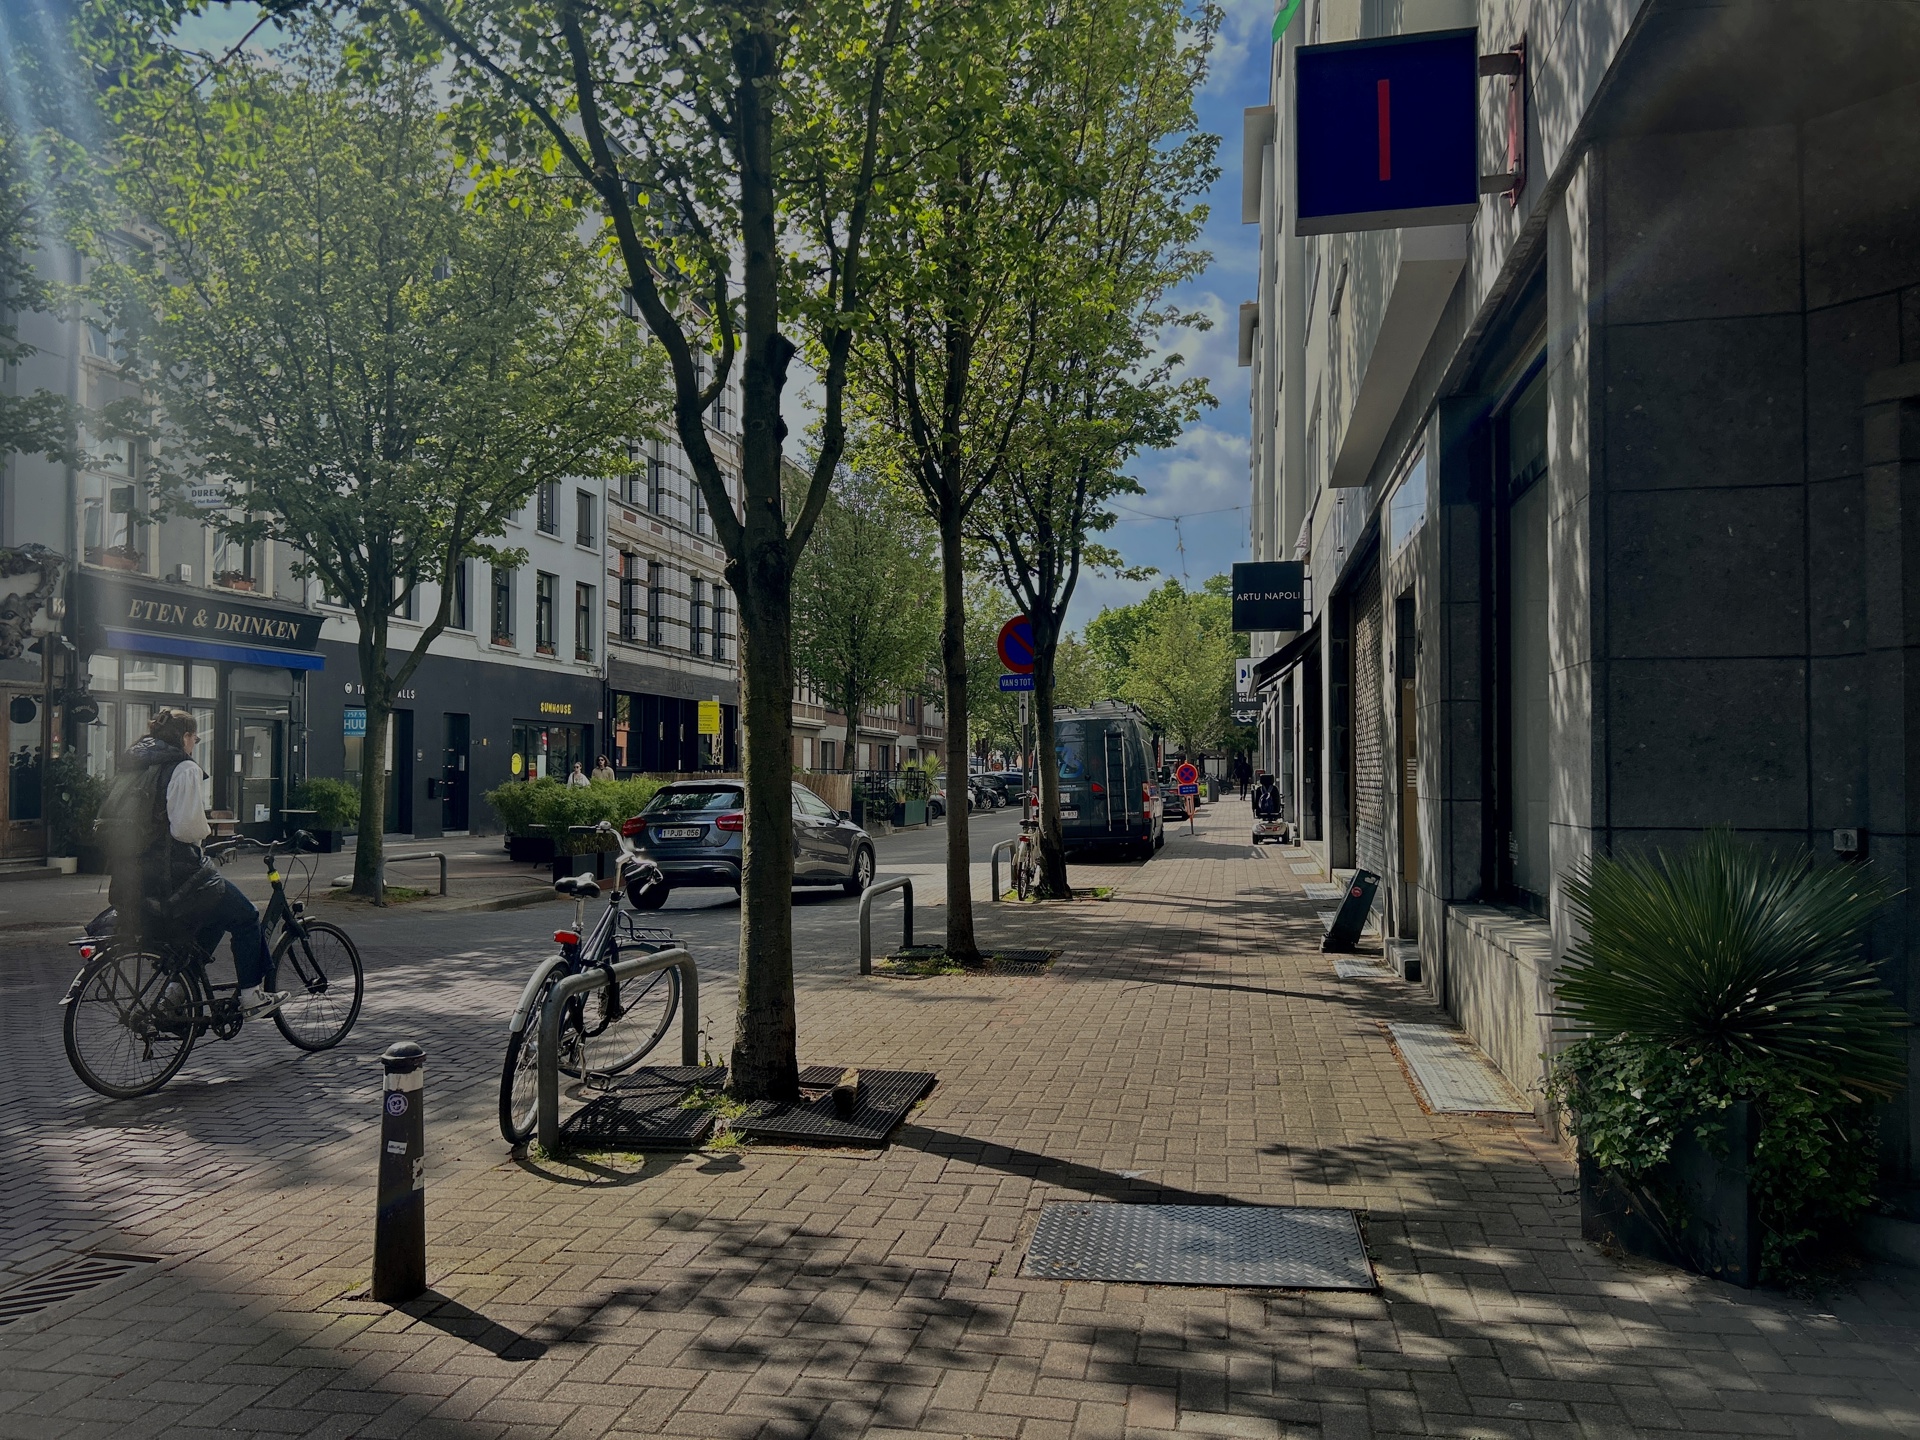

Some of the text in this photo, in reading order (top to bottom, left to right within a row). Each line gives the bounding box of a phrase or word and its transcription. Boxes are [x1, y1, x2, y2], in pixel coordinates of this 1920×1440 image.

[1236, 591, 1301, 601] ARTU NAPOLI
[128, 598, 302, 641] ETEN & DRINKEN
[1001, 678, 1031, 687] VAN 9 TOT
[540, 702, 572, 715] SUNHOUSE
[344, 719, 366, 730] HUU
